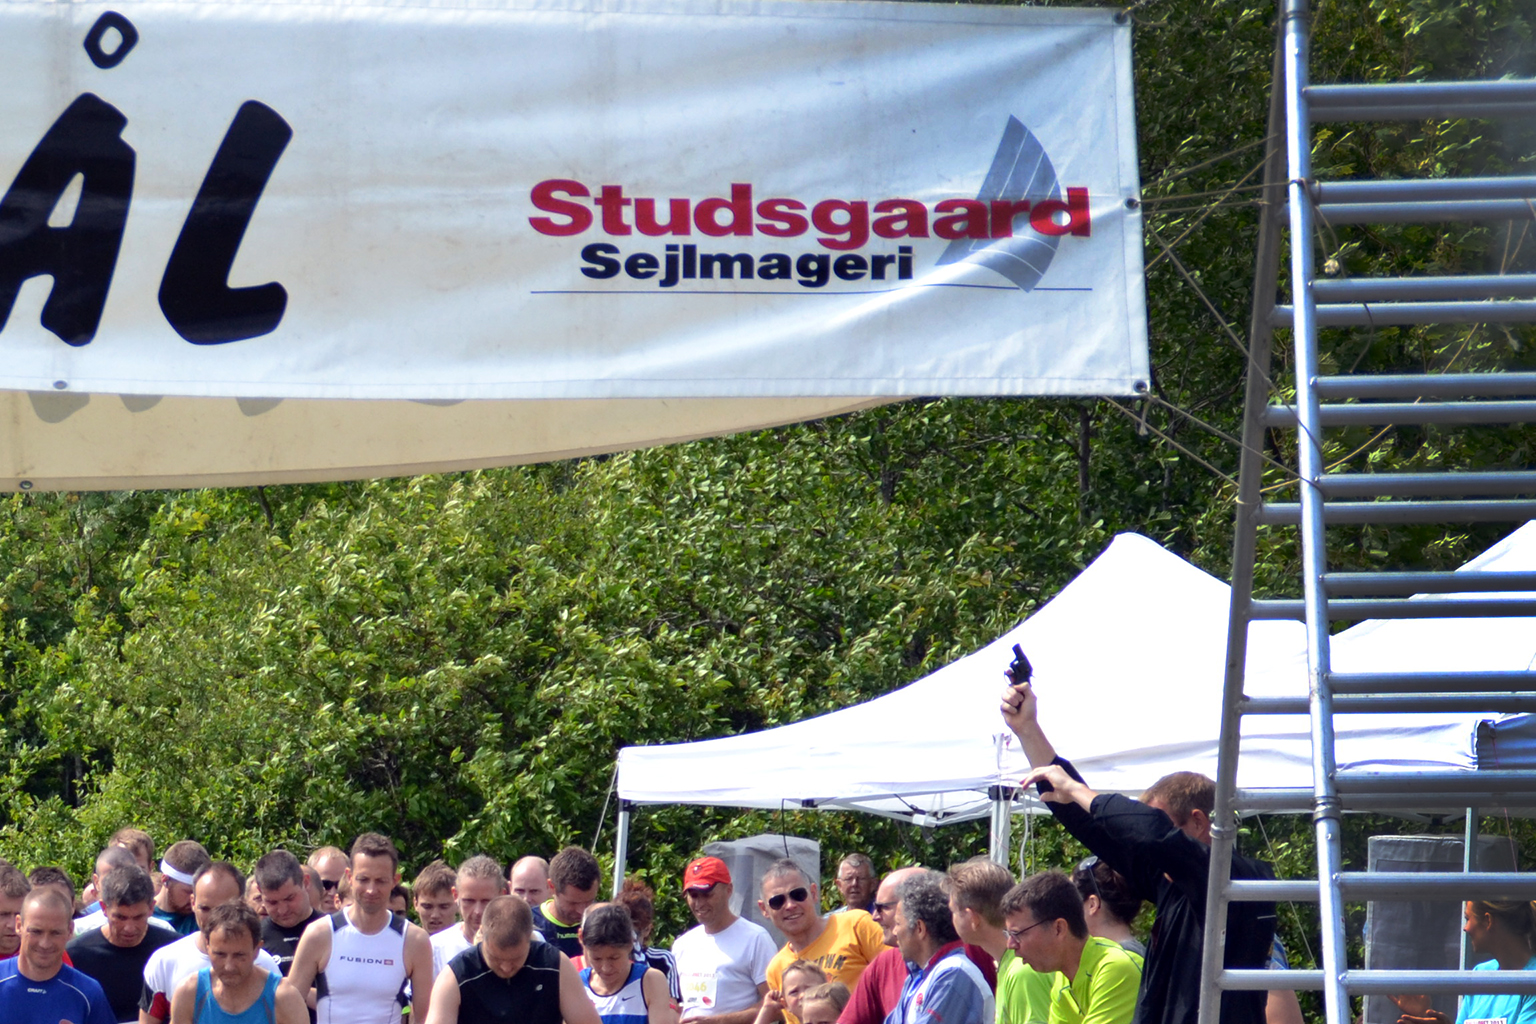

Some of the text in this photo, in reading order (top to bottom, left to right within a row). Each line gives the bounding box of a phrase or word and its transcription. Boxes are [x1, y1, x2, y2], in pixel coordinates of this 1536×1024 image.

[528, 178, 1092, 250] Studsgaard
[580, 243, 914, 288] Sejlmageri
[339, 956, 382, 964] FUSION
